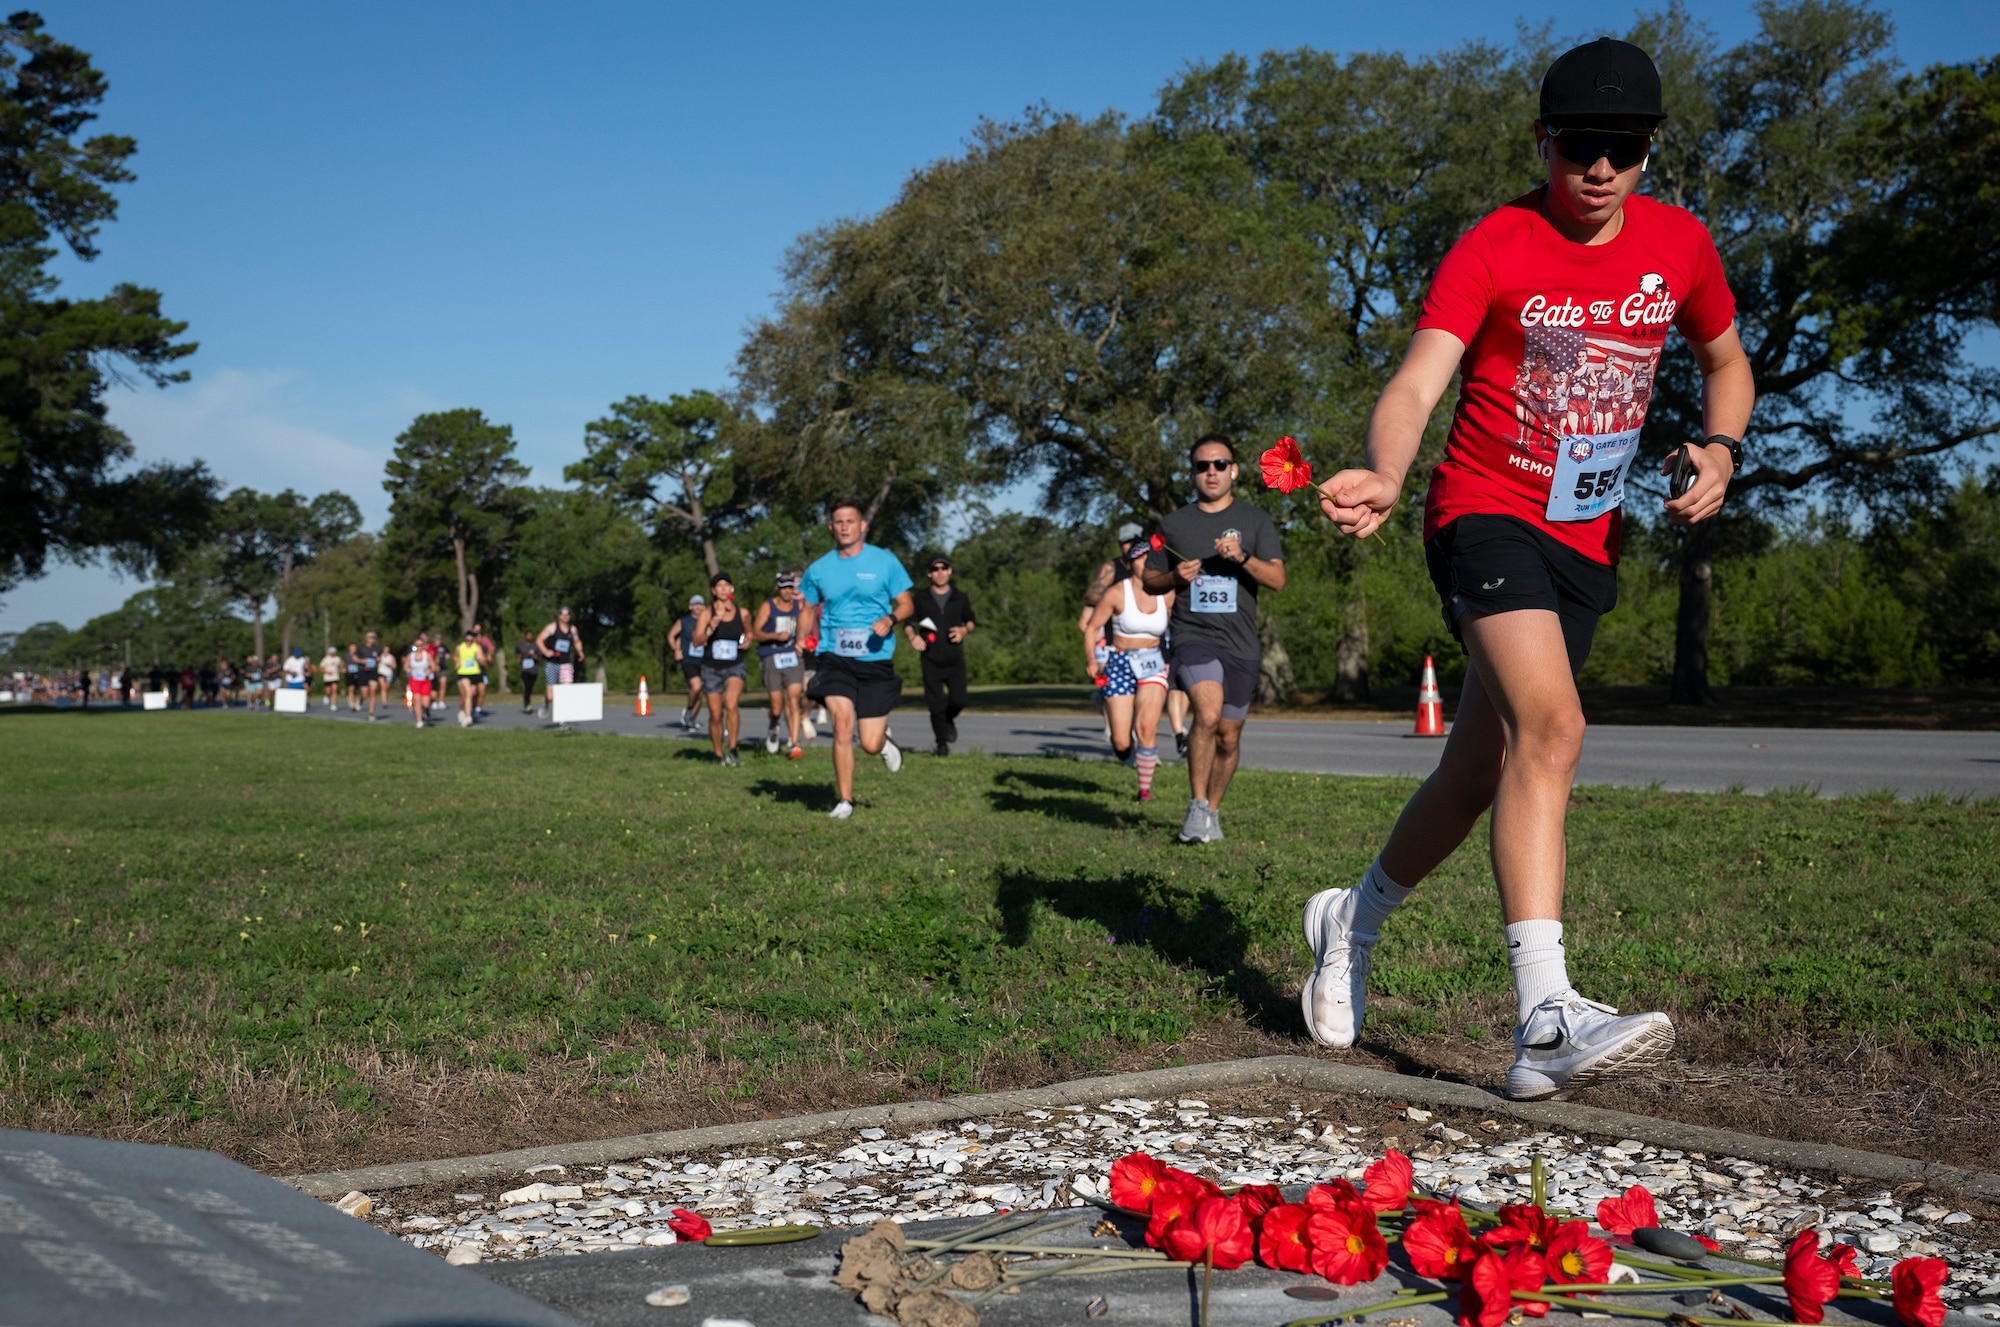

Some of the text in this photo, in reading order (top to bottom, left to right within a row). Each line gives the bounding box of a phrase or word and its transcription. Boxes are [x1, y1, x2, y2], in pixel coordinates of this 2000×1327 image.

[1520, 291, 1676, 327] Gate To Gate
[1632, 328, 1646, 337] 4.4
[1595, 440, 1617, 450] GATE
[1619, 438, 1628, 447] TO
[1508, 454, 1553, 477] MEMO
[1574, 464, 1622, 499] 553
[1199, 591, 1228, 603] 263
[840, 640, 862, 650] 646
